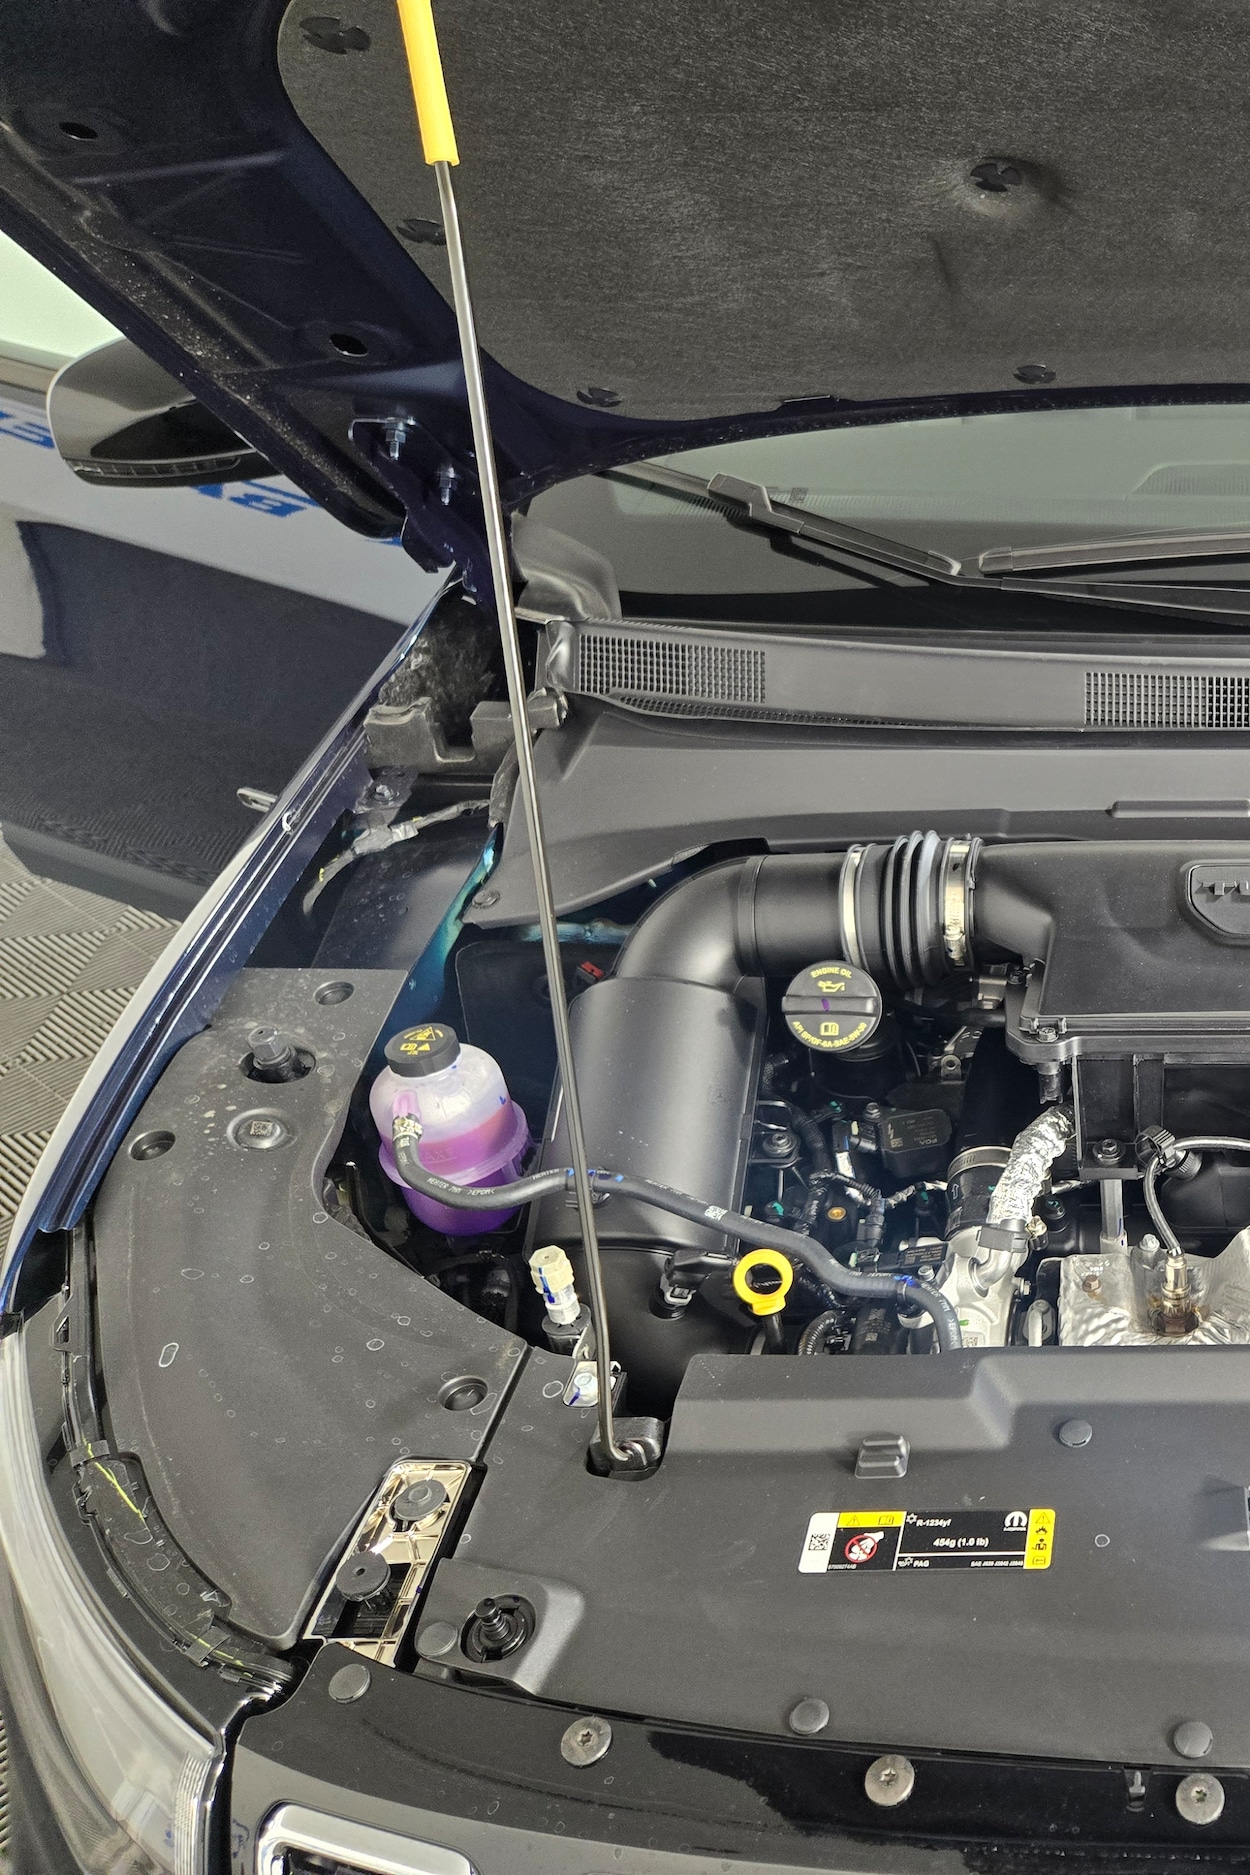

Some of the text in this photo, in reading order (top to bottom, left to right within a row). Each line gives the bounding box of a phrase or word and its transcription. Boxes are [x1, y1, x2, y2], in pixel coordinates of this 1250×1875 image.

[810, 966, 852, 979] ENGINE OIL
[792, 1021, 805, 1034] API
[426, 1177, 450, 1190] HEATER
[920, 1282, 941, 1298] HEATER
[915, 1518, 952, 1528] R-1234yf
[932, 1537, 990, 1549] 454g (1.0 lb)
[912, 1559, 930, 1568] PAG
